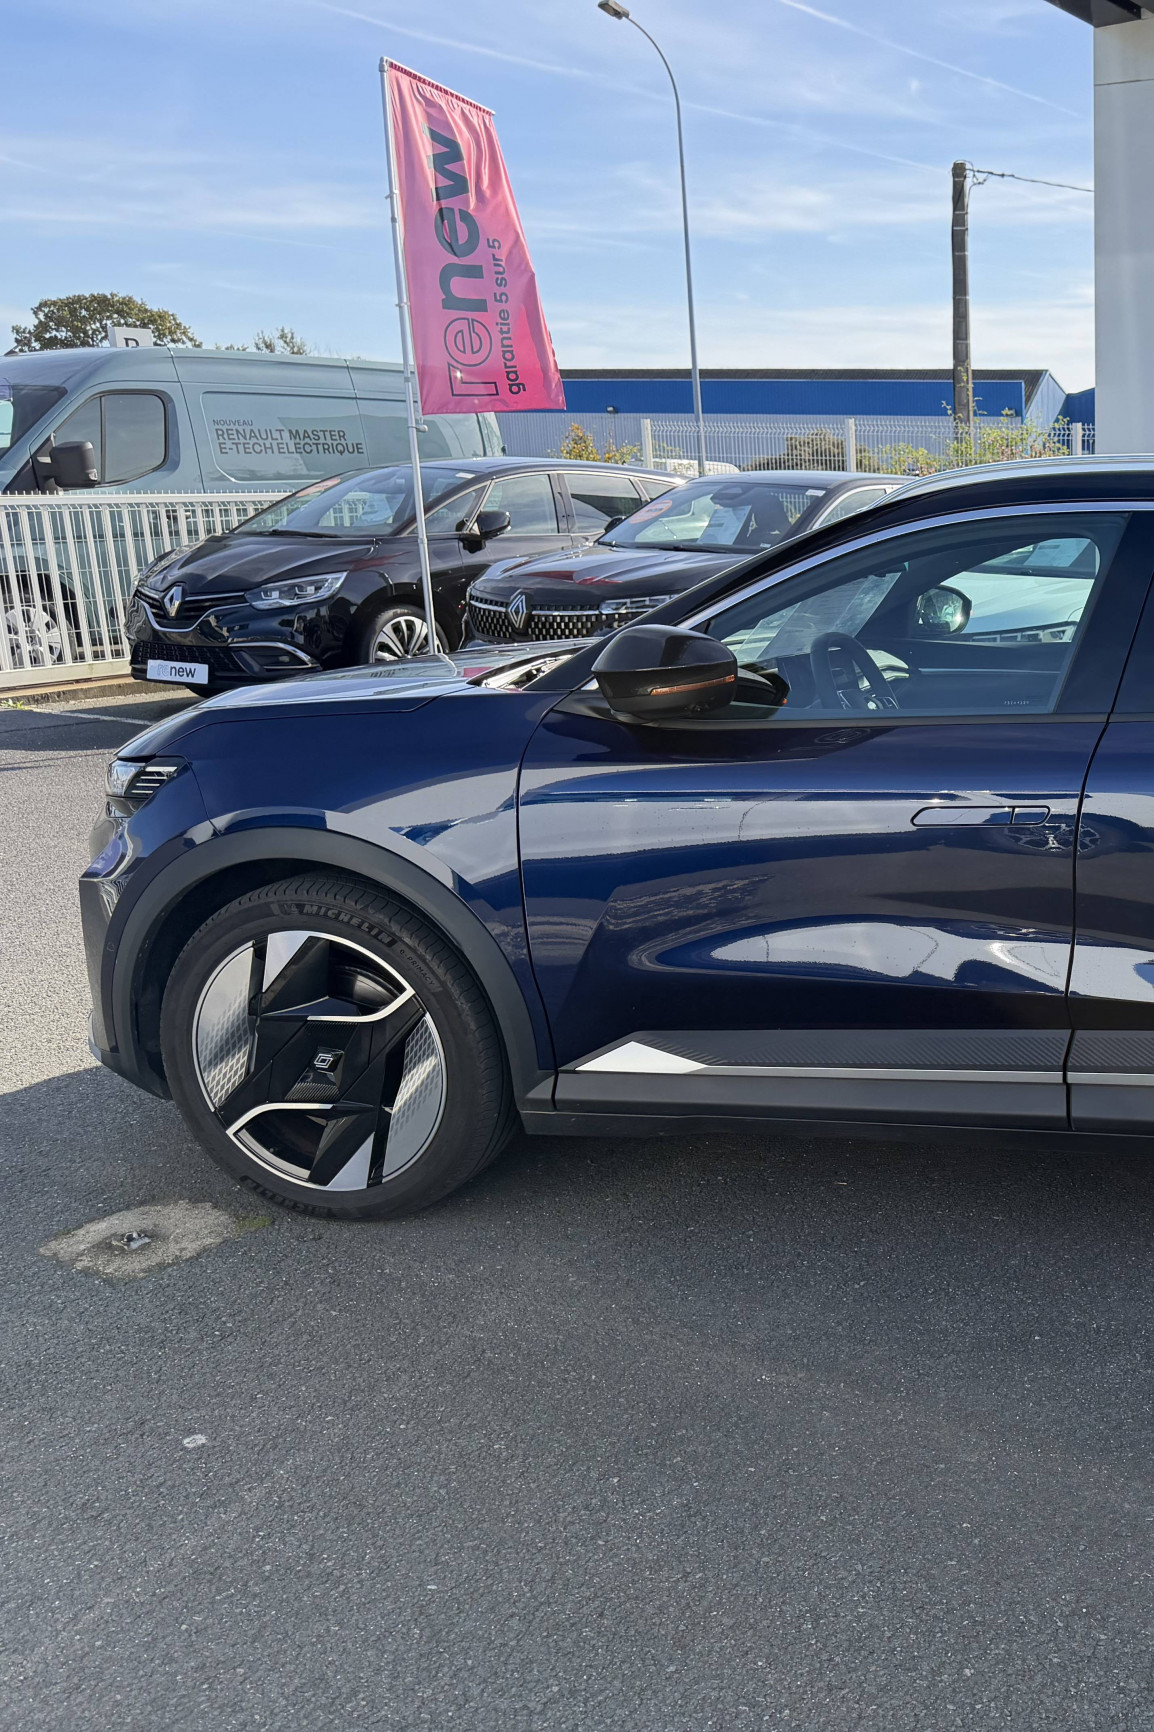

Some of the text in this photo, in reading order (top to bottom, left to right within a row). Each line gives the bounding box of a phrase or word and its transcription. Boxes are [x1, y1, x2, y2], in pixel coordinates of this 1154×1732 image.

[421, 120, 500, 398] renew
[487, 237, 527, 395] garantie 5 sur 5
[212, 419, 254, 427] NOUVEAU
[215, 428, 347, 442] RENAULT MASTER
[218, 442, 365, 456] E-TECH ELECTRIQUE
[303, 903, 394, 945] MICHELIN
